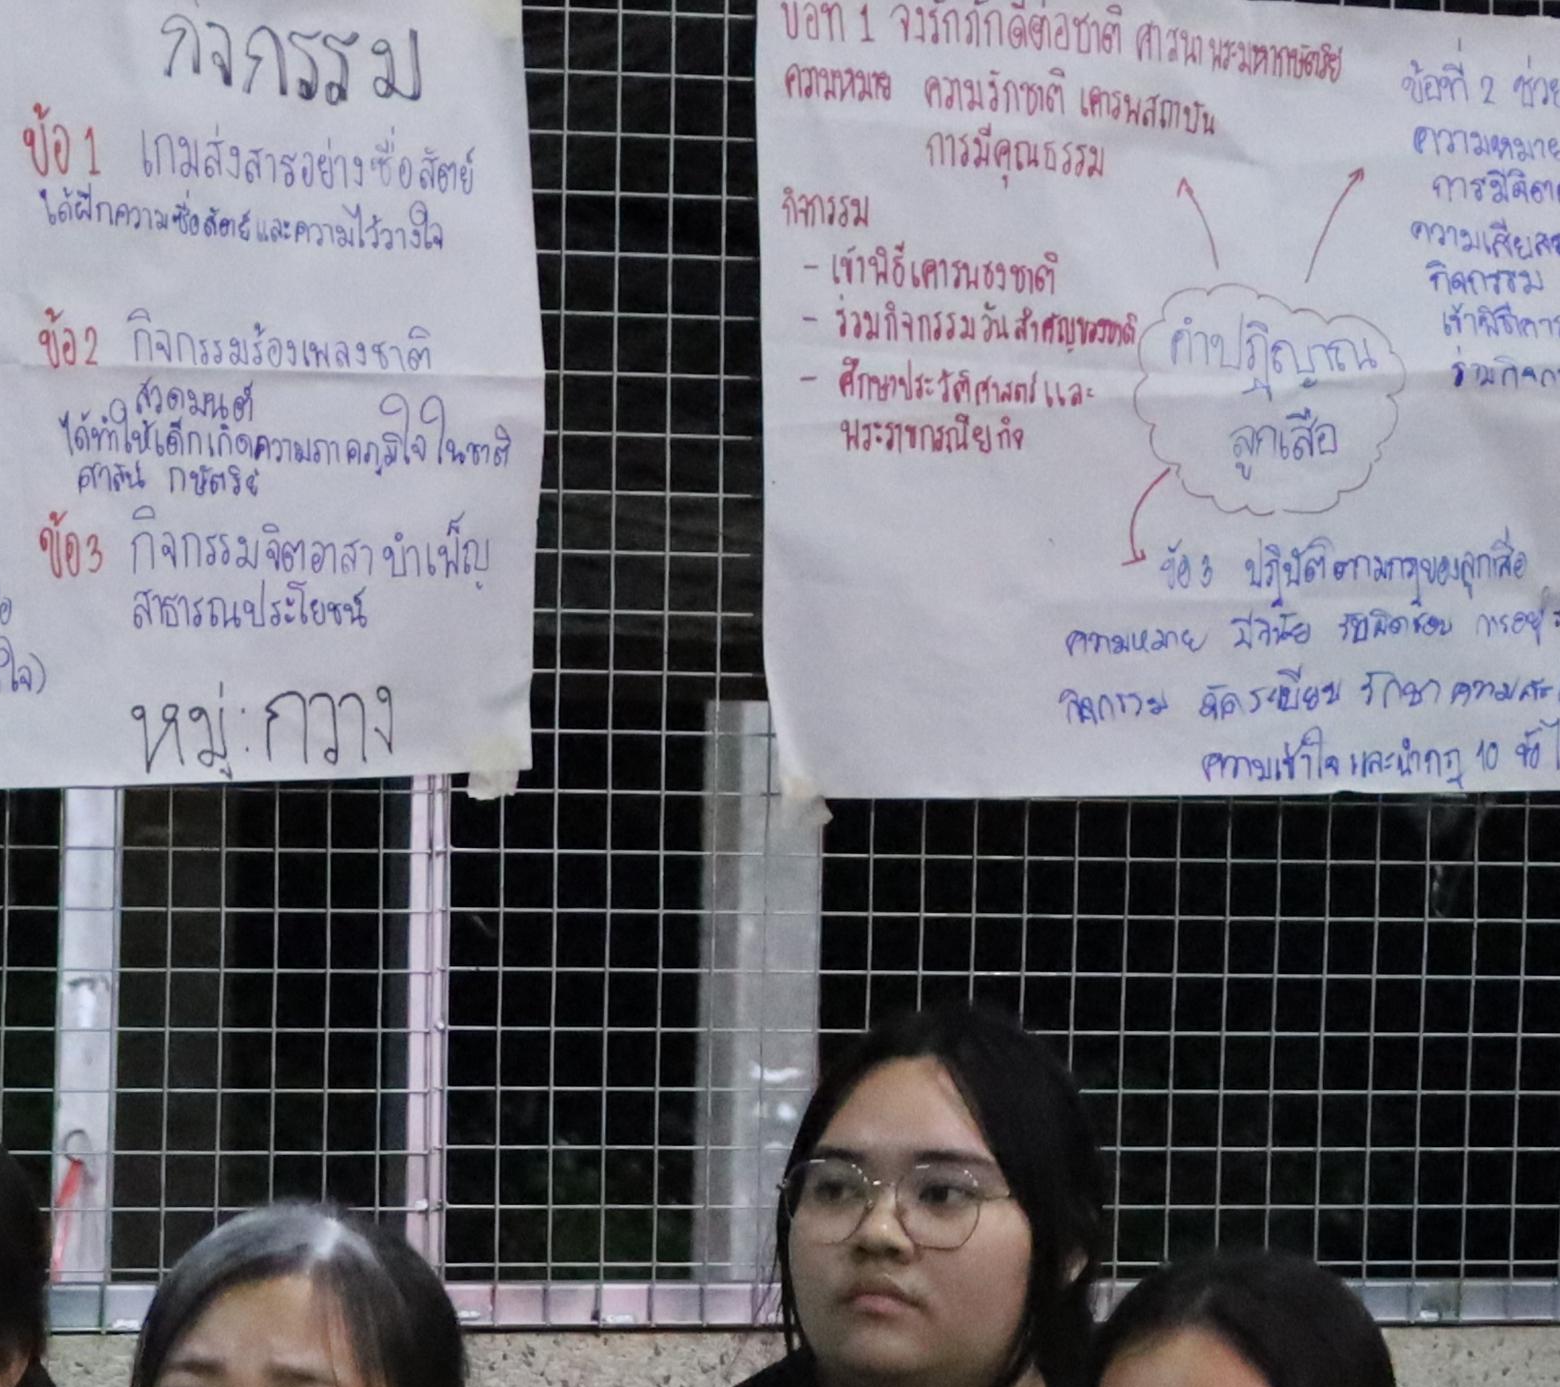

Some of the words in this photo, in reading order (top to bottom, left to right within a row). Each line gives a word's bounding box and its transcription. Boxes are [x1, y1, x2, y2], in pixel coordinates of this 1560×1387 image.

[160, 8, 423, 105] กจกรรม
[784, 62, 892, 102] ความหมาย
[923, 67, 1067, 115] ความรักชาติ
[925, 124, 1105, 191] การมีคุณธรรม
[781, 186, 870, 229] กิจกรรม
[126, 307, 432, 372] กิจกรรมร้องเพลงชาติ
[1231, 407, 1338, 480] ลูกเสือ
[264, 684, 395, 765] กวาง
